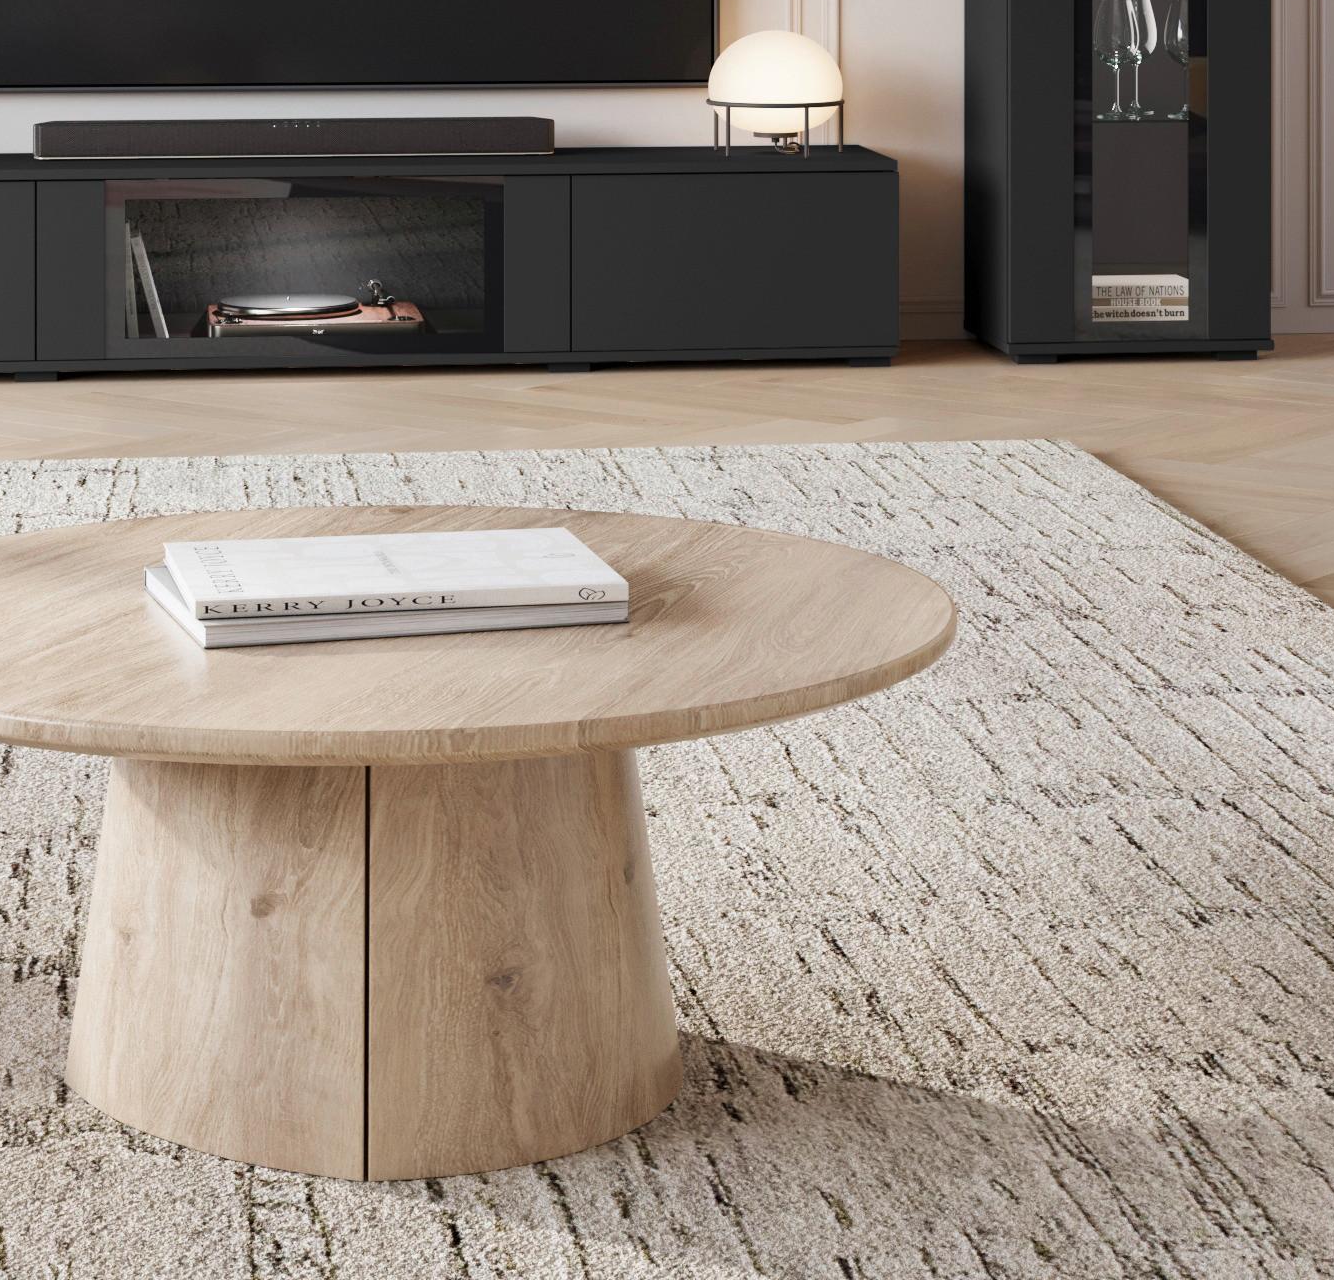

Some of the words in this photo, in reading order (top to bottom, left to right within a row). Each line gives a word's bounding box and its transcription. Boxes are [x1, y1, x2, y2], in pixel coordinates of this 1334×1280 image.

[1096, 286, 1113, 297] THE
[1115, 286, 1133, 297] LAW
[1135, 285, 1146, 297] OF
[1148, 285, 1185, 296] NATIONS
[1110, 298, 1138, 306] HOUSE
[1139, 298, 1161, 306] BOOK
[1105, 309, 1131, 318] witch
[1130, 308, 1163, 318] doesn't
[1164, 308, 1185, 317] burn
[203, 600, 325, 614] KERRY
[346, 594, 457, 610] JOYCE
